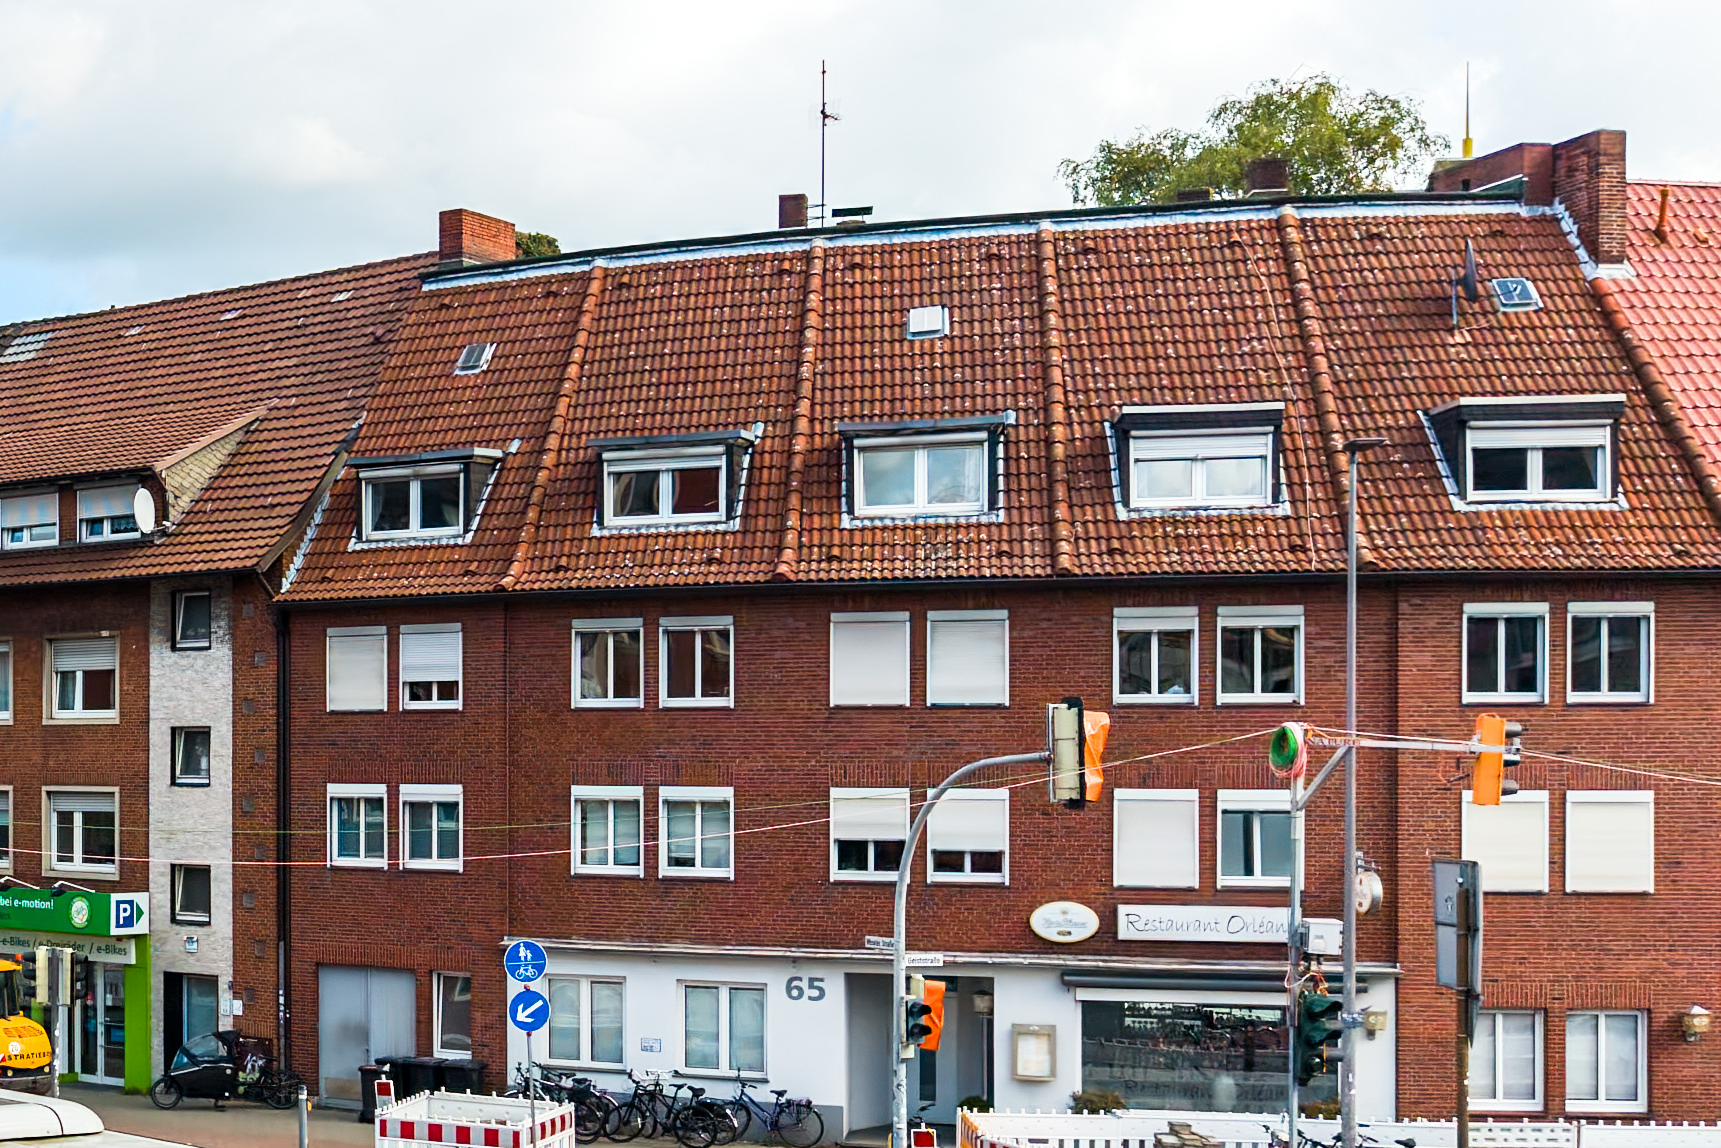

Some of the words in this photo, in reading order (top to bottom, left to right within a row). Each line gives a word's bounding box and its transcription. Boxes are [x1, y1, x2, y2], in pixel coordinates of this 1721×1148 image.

[0, 896, 13, 907] bei
[14, 898, 54, 910] e-motion!
[1125, 912, 1221, 933] Restaurant
[96, 944, 127, 956] e-Bikes
[785, 975, 826, 1002] 65
